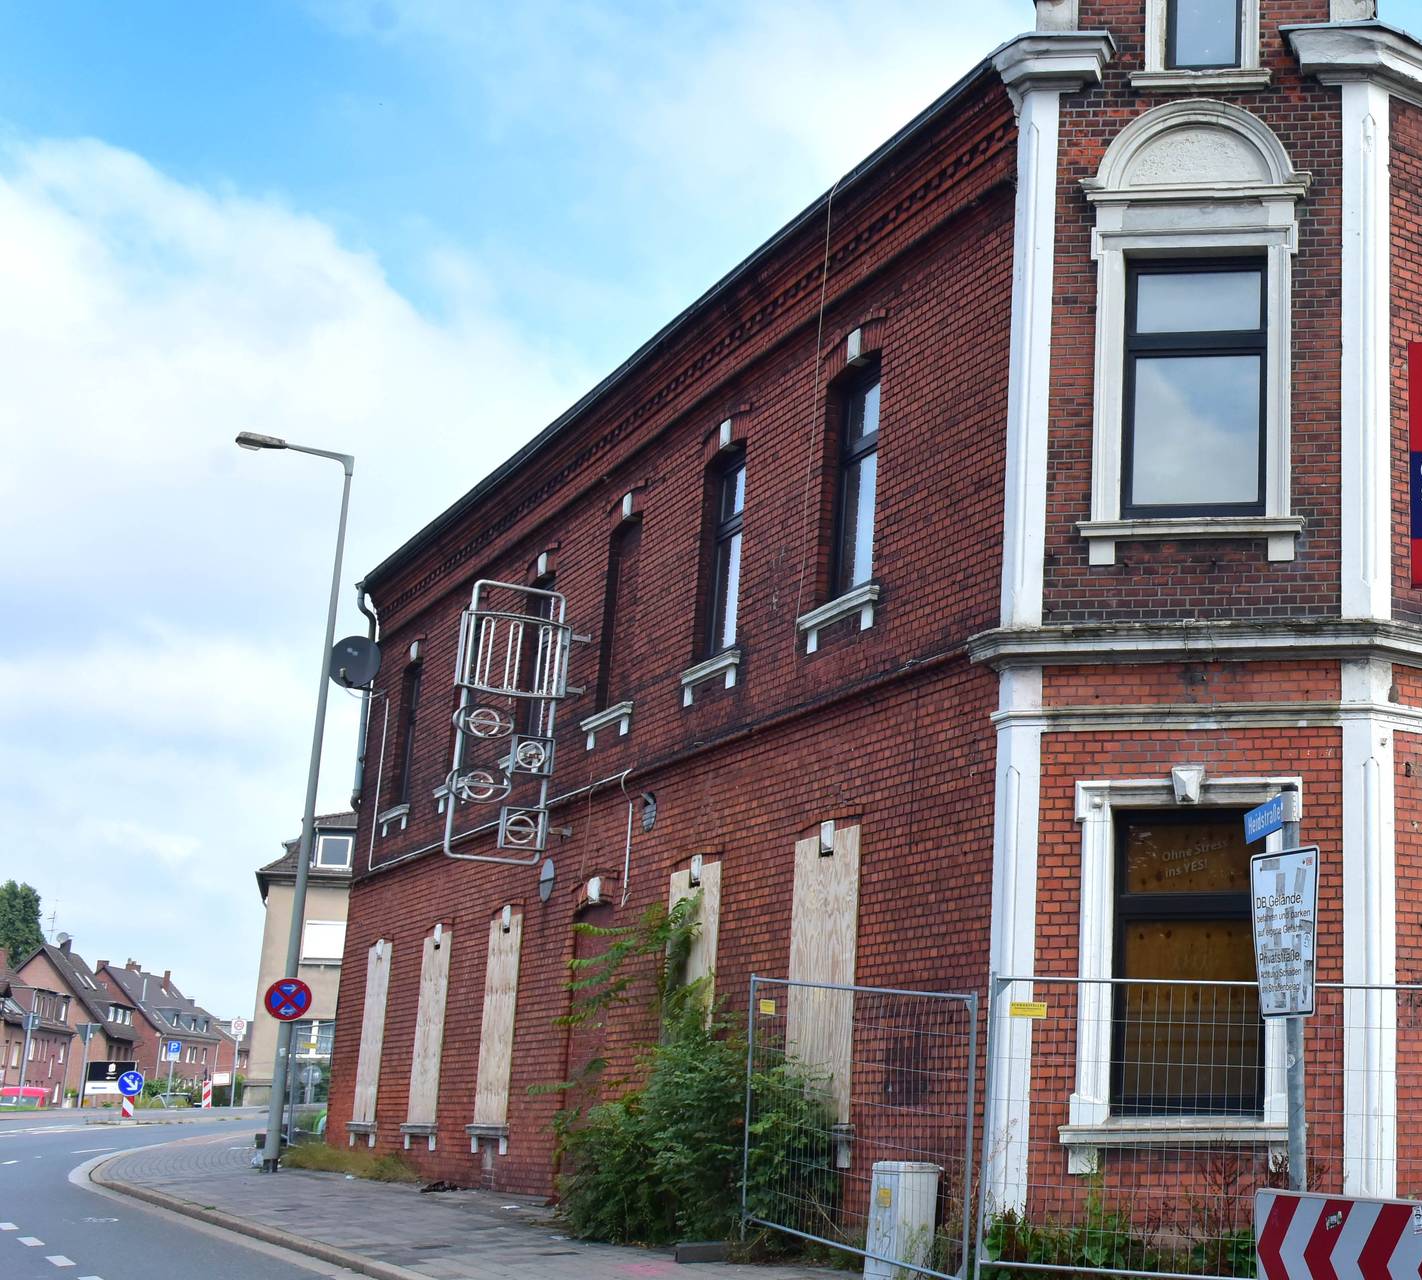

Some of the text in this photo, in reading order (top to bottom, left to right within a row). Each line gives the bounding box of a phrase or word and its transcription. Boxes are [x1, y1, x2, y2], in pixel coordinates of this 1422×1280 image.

[1162, 848, 1192, 862] Ohne
[1164, 858, 1208, 879] ins YES!
[1256, 892, 1303, 909] DB Gelände,
